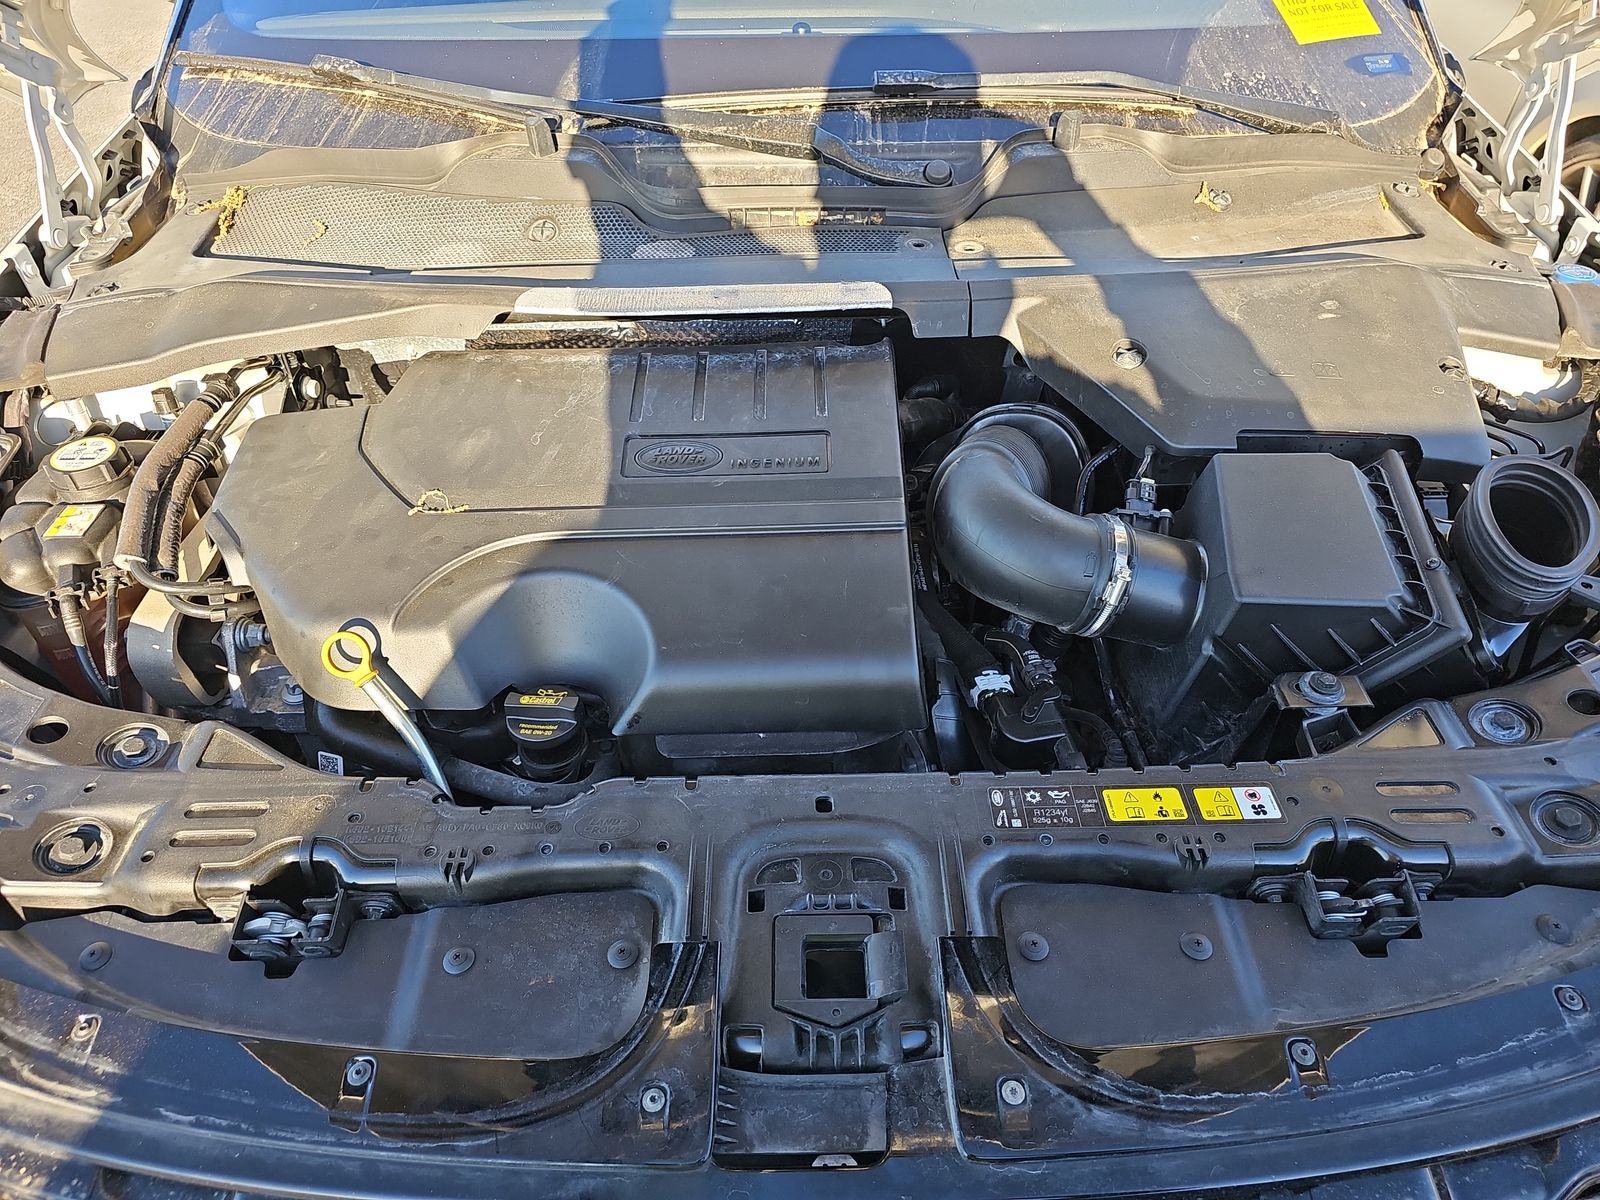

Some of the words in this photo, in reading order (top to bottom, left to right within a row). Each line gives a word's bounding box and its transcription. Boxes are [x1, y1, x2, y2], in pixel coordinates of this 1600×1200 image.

[1287, 6, 1309, 17] NOT
[1311, 3, 1334, 14] FOR
[1334, 1, 1360, 11] SALE
[654, 446, 694, 456] LAND
[655, 455, 707, 465] ROVER
[730, 456, 821, 470] INGENIUM
[529, 696, 556, 704] Castrol
[1033, 808, 1069, 818] R1234yf
[1032, 817, 1051, 825] 525g
[1060, 816, 1074, 824] 10g
